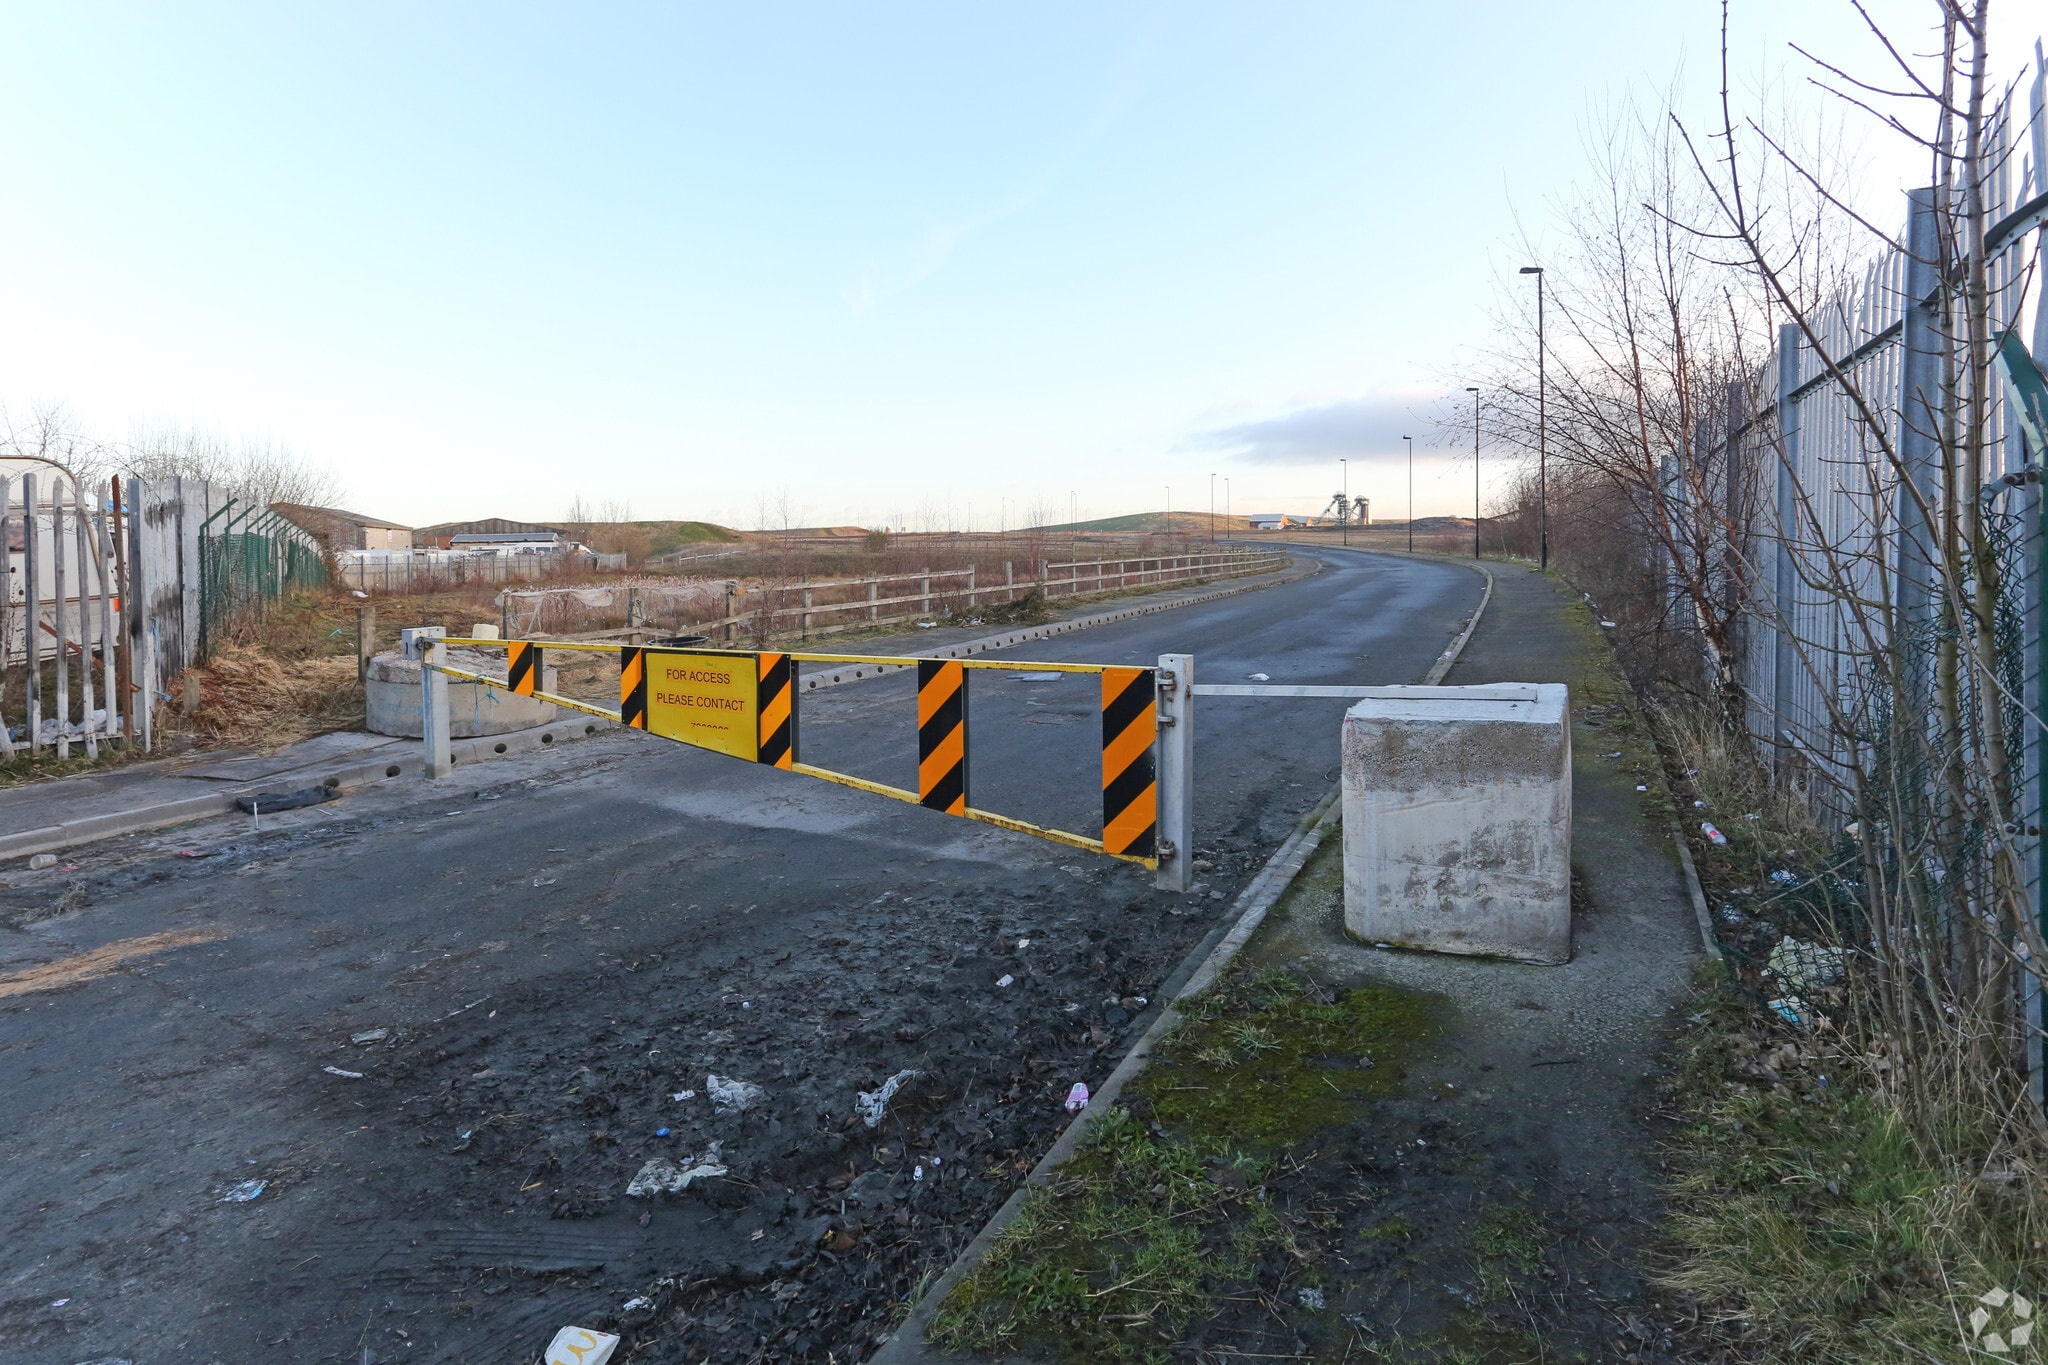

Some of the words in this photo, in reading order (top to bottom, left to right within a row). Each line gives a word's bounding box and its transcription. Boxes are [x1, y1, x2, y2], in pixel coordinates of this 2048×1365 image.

[666, 668, 687, 681] FOR
[689, 671, 731, 685] ACCESS
[656, 692, 694, 707] PLEASE
[696, 696, 745, 712] CONTACT
